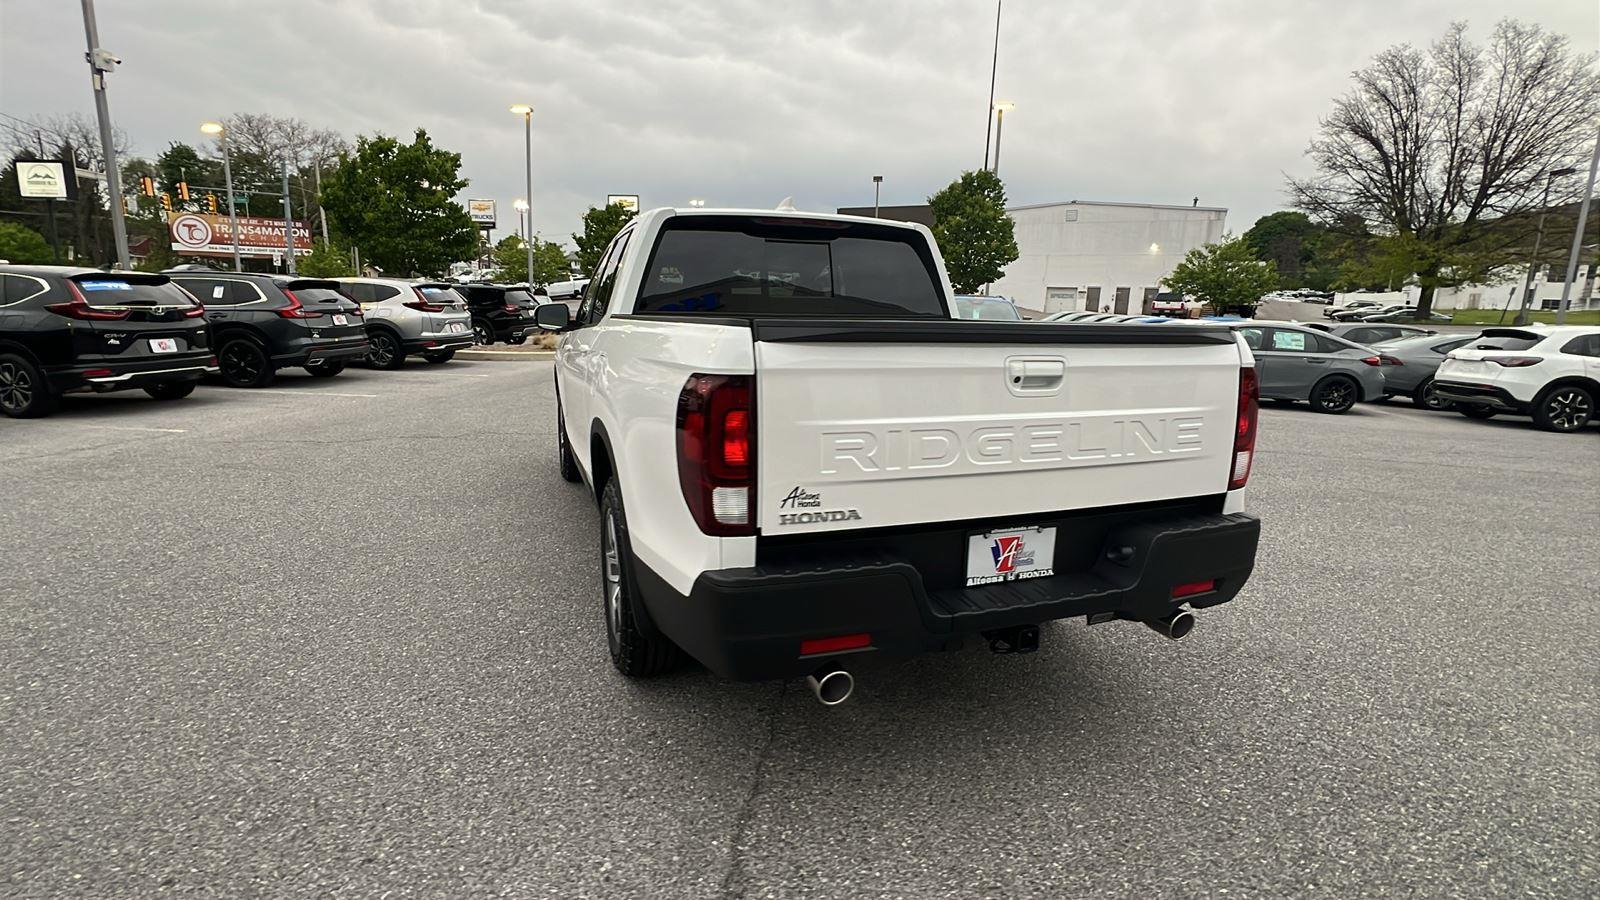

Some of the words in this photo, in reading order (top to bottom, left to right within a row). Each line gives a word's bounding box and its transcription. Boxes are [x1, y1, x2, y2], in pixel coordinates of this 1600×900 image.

[213, 223, 309, 238] TRNS4MATON
[820, 416, 1204, 474] RIDGELINE
[779, 509, 862, 525] HONDA
[966, 575, 1004, 587] Altoona
[1019, 569, 1055, 580] HONDA
